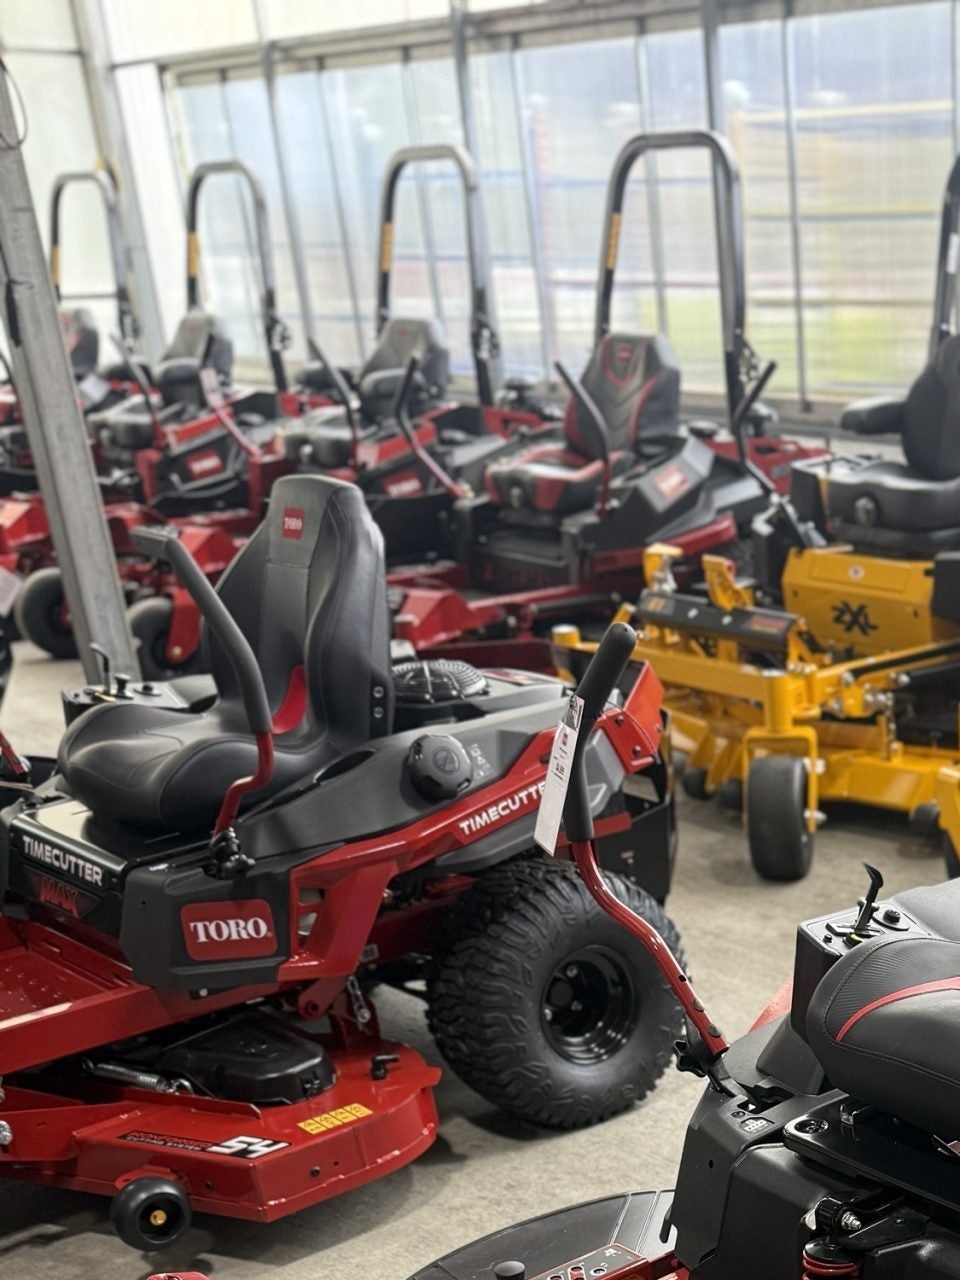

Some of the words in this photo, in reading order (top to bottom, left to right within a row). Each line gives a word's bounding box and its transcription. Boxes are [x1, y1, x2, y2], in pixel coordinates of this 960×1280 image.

[22, 835, 103, 887] TIMECUTTER
[38, 876, 80, 919] MAX
[189, 917, 269, 943] TORO
[205, 1135, 291, 1159] 54
